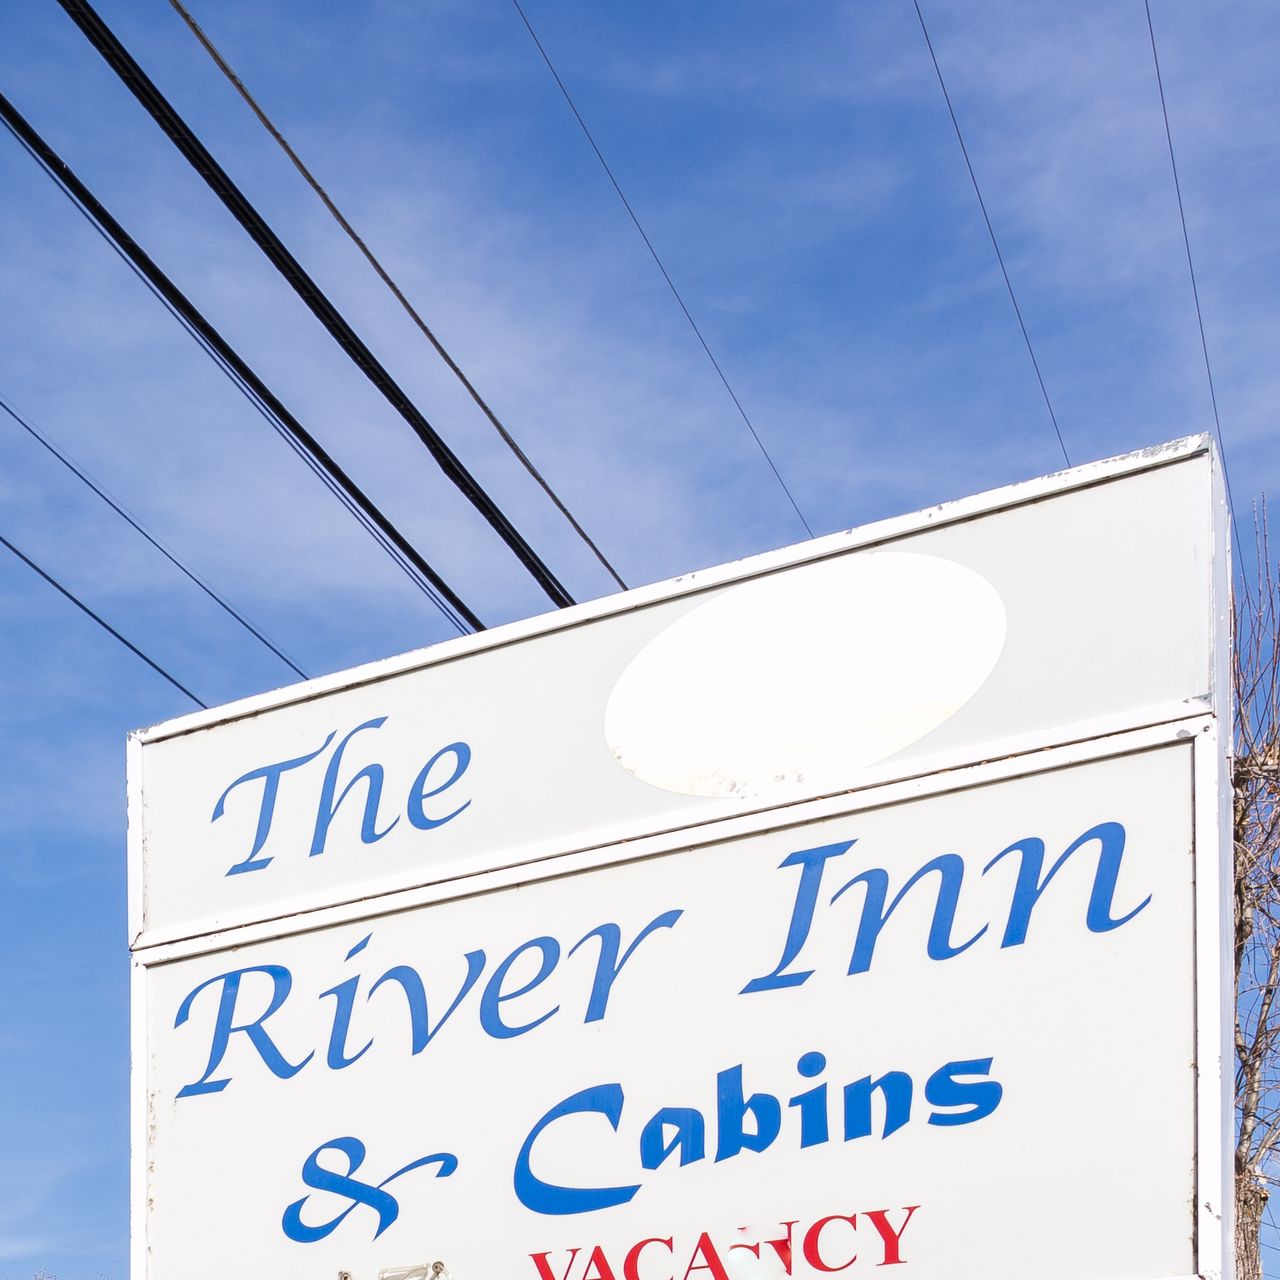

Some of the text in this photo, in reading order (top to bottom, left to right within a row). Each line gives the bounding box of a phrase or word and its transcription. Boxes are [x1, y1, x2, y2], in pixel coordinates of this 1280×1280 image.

[213, 716, 471, 876] The
[175, 822, 1152, 1098] River Inn
[282, 1052, 1002, 1244] & Cabins
